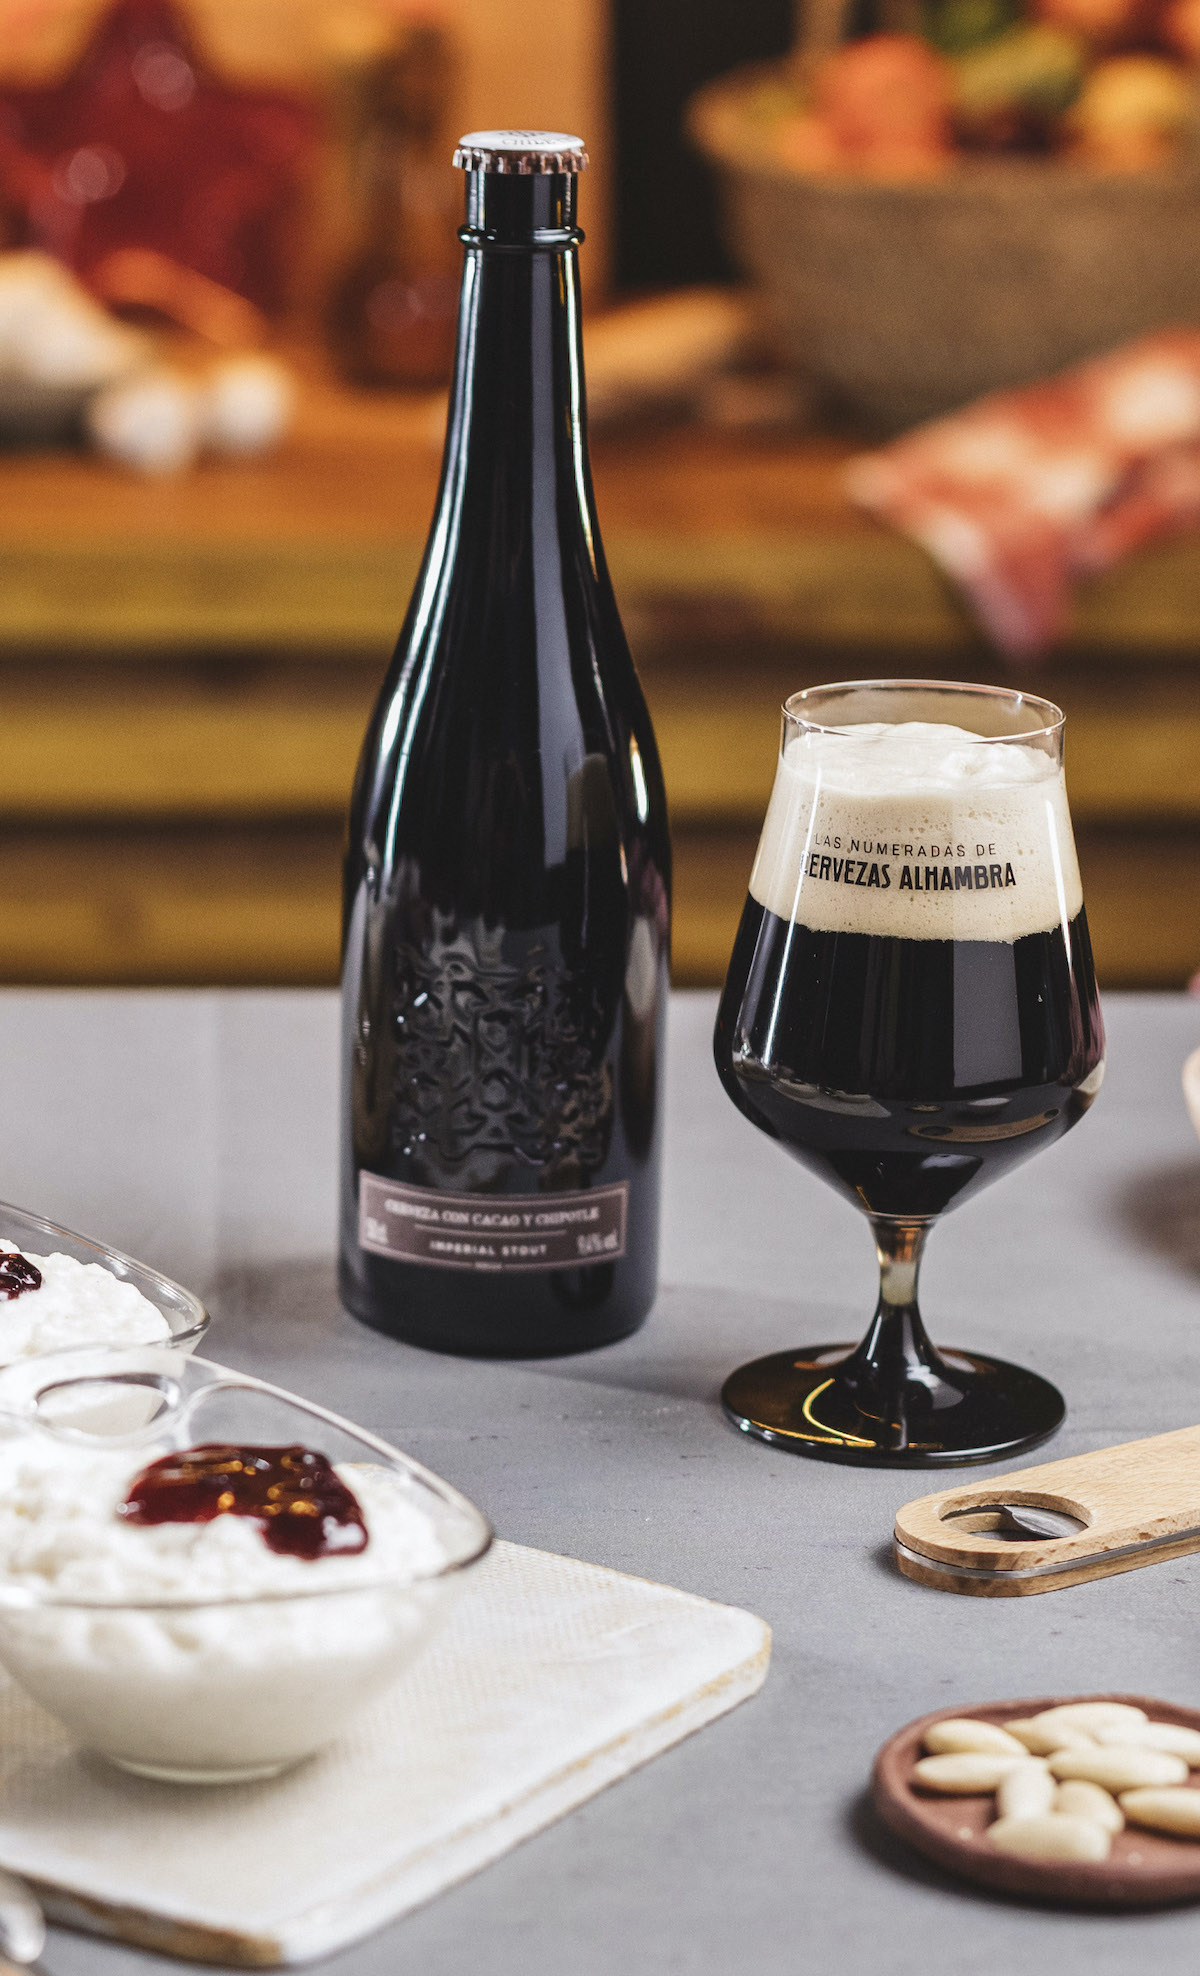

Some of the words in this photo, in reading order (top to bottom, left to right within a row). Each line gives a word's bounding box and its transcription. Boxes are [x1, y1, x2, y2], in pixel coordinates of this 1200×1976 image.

[815, 832, 842, 849] LAS
[850, 839, 966, 858] NUMERADAS
[975, 843, 996, 856] DE
[899, 862, 1017, 891] ALHAMBRA
[441, 1209, 470, 1225] CON
[471, 1212, 521, 1227] CACAO
[522, 1213, 533, 1227] Y
[534, 1206, 600, 1226] CHIPOTLE
[429, 1240, 496, 1257] IMPERIAL
[501, 1243, 547, 1257] STOUT
